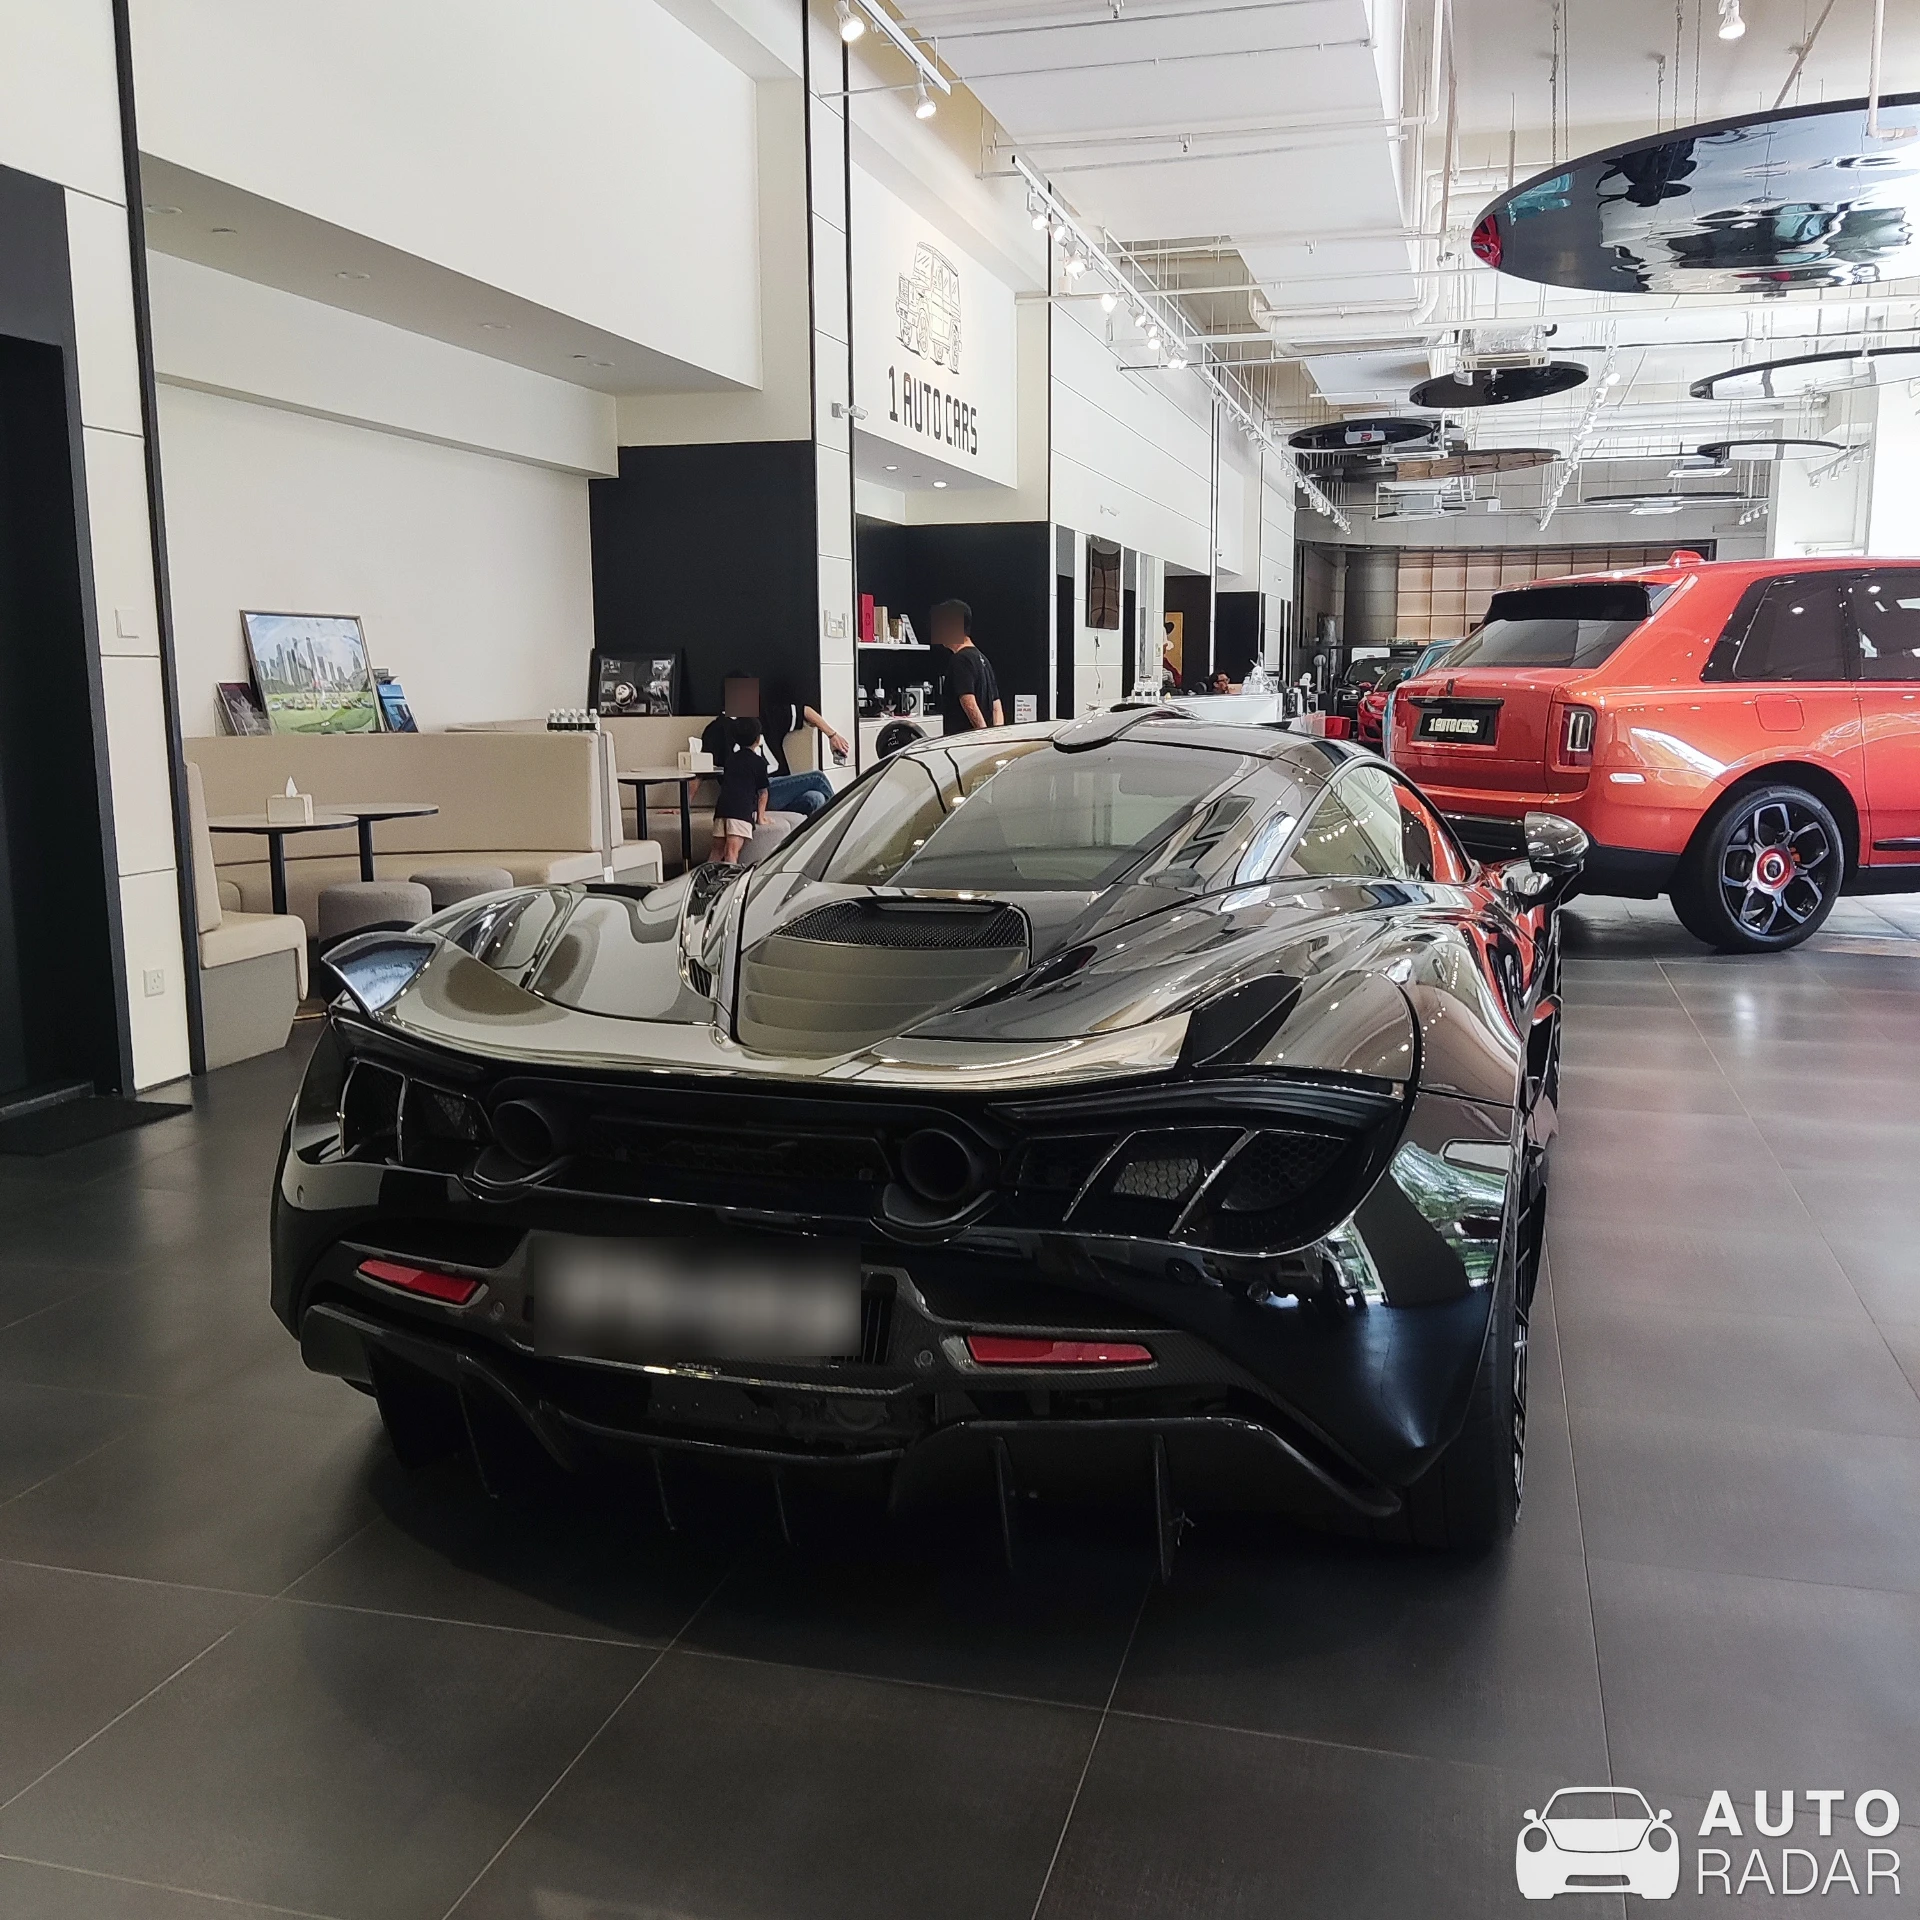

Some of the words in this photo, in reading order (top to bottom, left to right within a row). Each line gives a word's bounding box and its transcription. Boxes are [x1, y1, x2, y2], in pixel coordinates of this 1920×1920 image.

[888, 365, 898, 422] 1
[904, 372, 941, 440] AUTO
[946, 394, 977, 455] CARS
